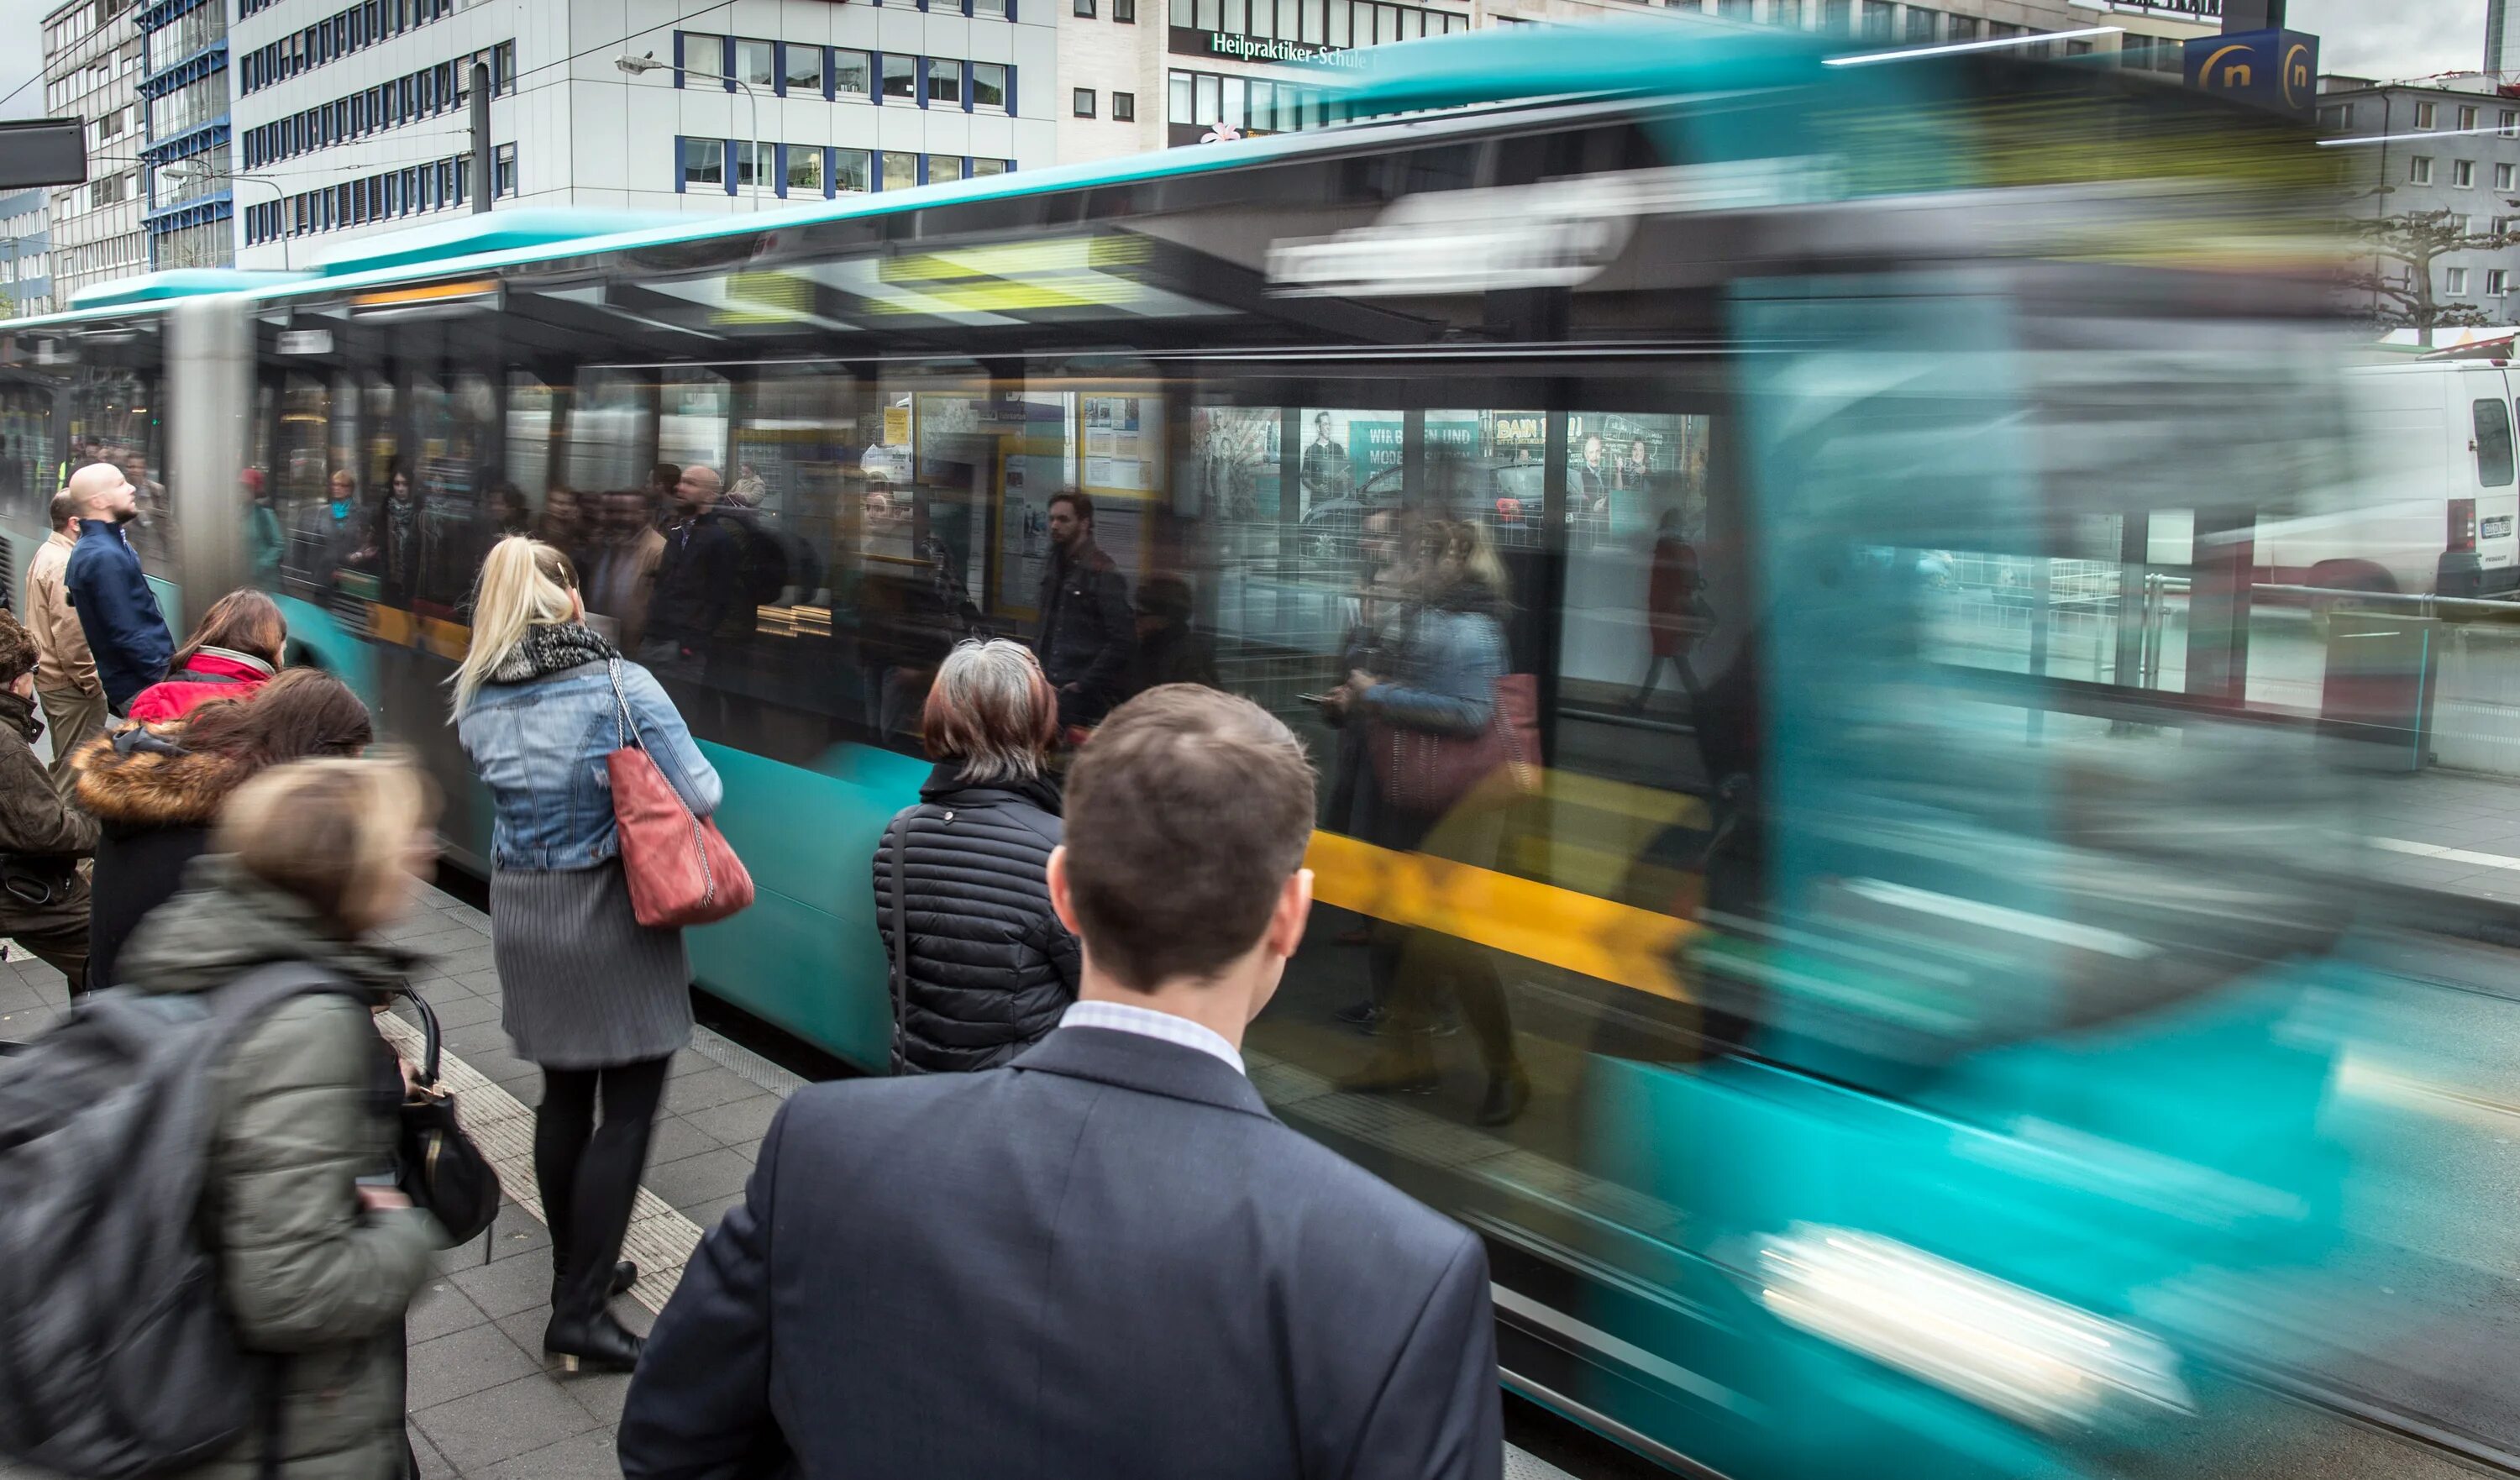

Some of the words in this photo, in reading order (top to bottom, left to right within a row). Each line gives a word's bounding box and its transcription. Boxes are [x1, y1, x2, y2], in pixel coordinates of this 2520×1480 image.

[1212, 32, 1367, 69] Heilpraktiker-Schule
[1370, 429, 1393, 443] WIR
[1443, 429, 1470, 443] UND
